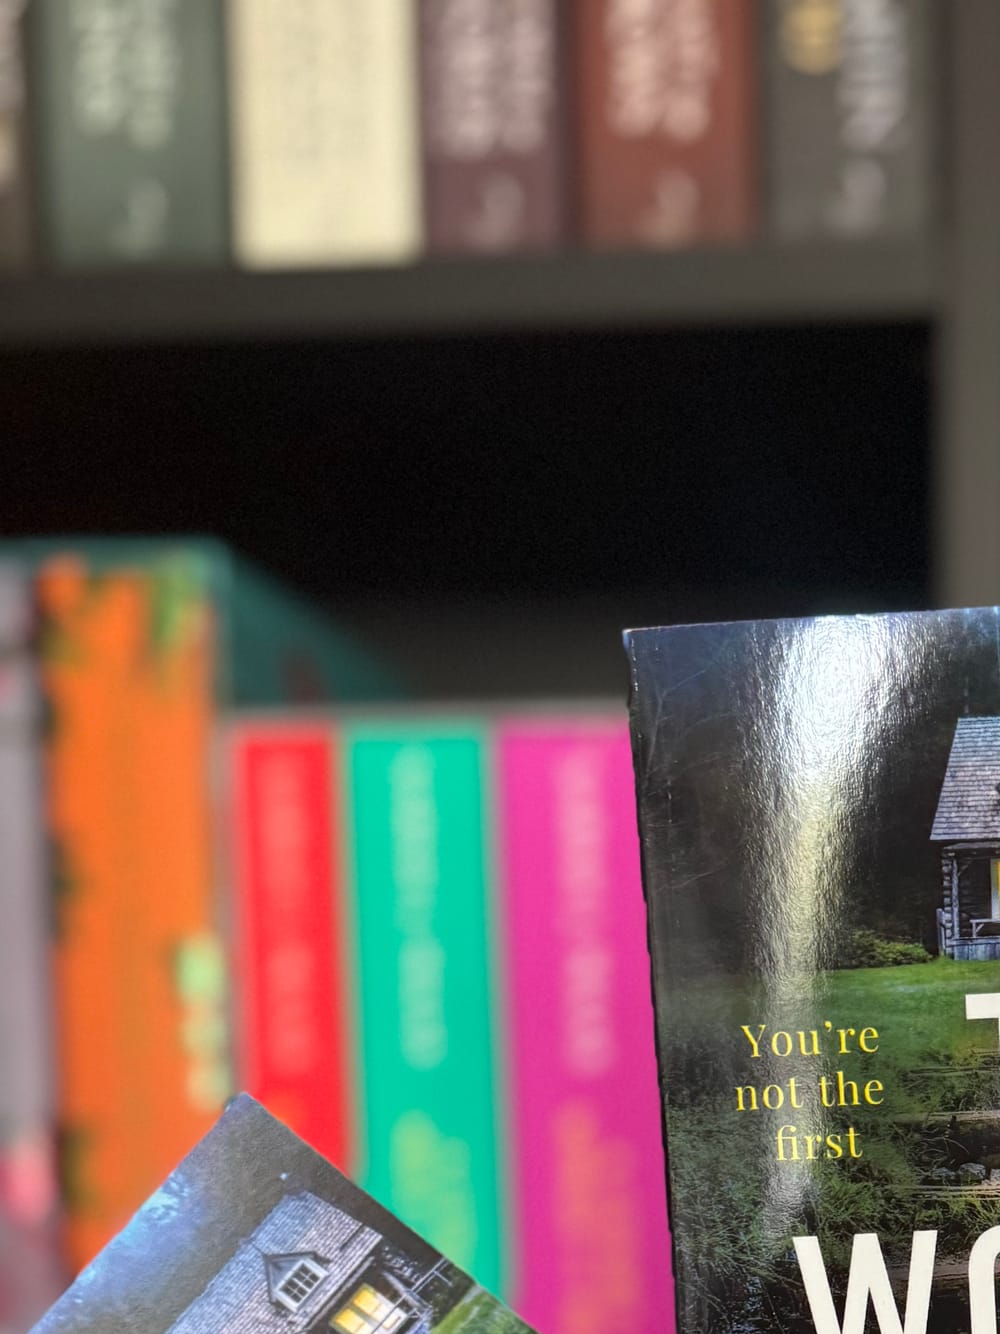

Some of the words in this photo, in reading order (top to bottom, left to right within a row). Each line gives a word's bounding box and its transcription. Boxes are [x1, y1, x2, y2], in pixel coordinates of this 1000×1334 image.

[740, 1020, 881, 1059] You're
[734, 1076, 805, 1112] not
[818, 1070, 885, 1109] the
[775, 1124, 864, 1162] first
